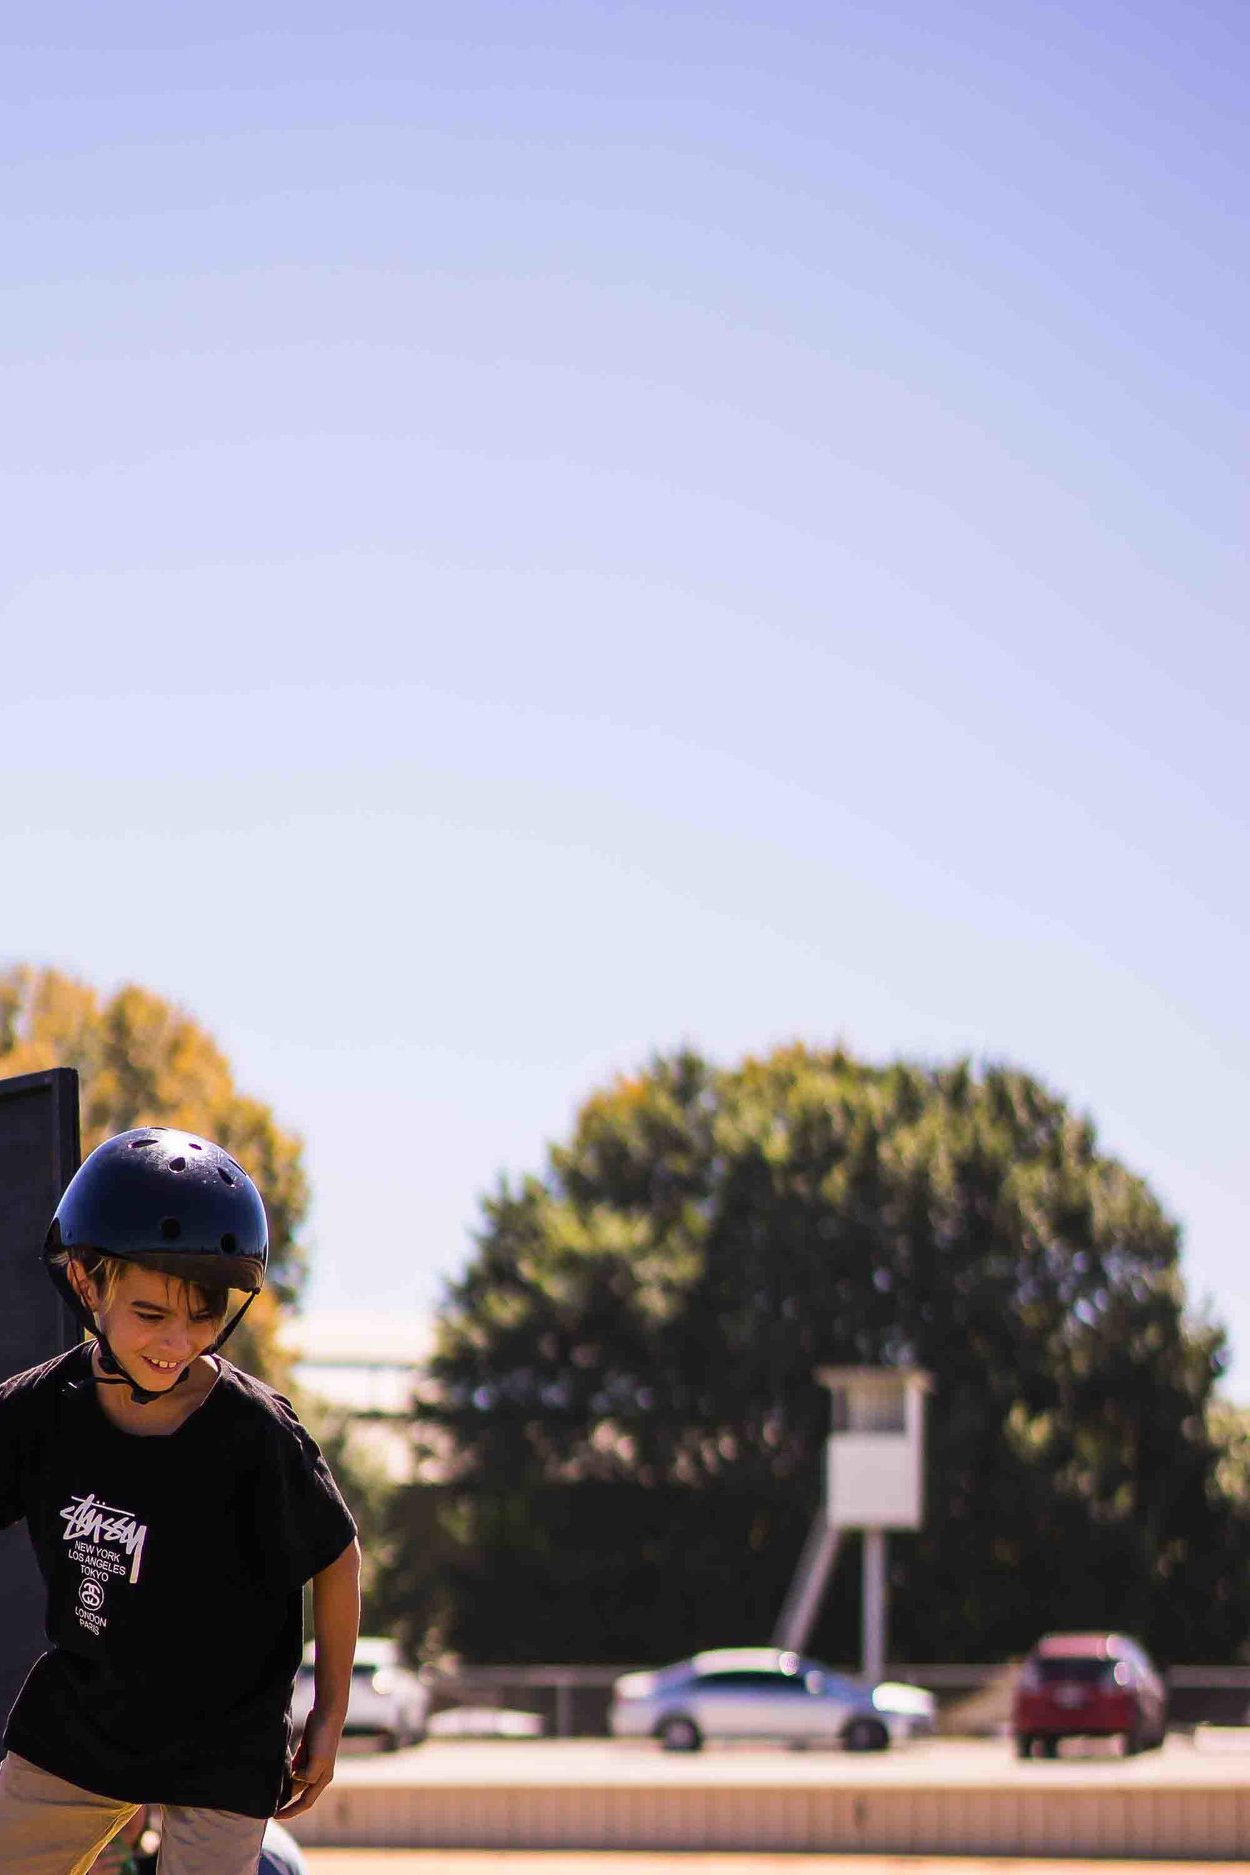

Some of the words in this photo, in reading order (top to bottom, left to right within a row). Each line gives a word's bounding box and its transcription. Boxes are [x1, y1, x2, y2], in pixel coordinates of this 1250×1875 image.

[68, 1548, 85, 1562] LOS
[84, 1555, 126, 1576] ANGELES
[75, 1540, 95, 1555] NEW
[96, 1546, 121, 1563] YORK
[80, 1564, 109, 1582] TOKYO
[75, 1605, 107, 1628] LONDON
[79, 1618, 100, 1636] PARIS
